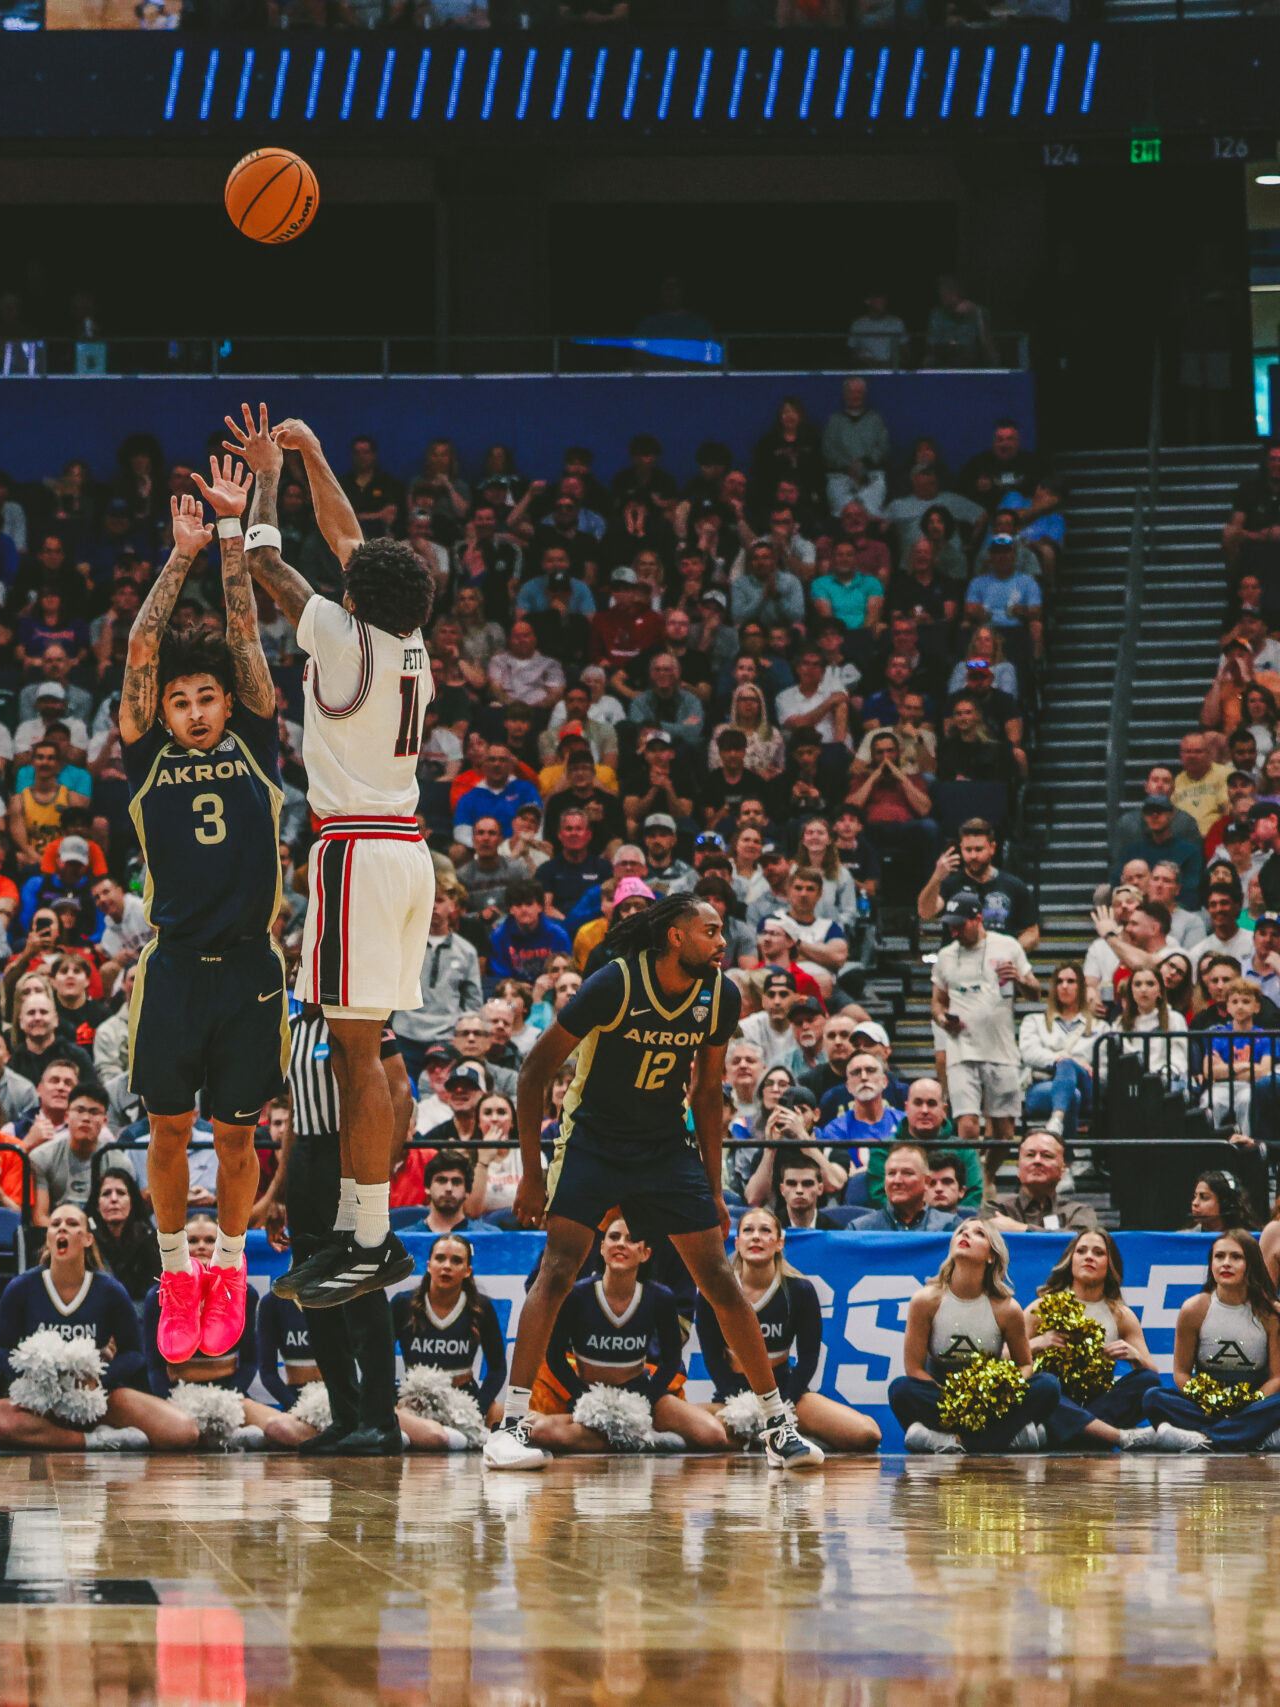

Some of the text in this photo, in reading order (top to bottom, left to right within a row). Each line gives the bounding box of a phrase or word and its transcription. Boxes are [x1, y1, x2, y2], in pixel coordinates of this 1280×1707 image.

[1043, 144, 1079, 166] 124
[1131, 139, 1161, 163] EXIT
[1213, 136, 1248, 159] 126
[403, 648, 424, 670] PETT
[394, 675, 419, 757] 11
[156, 760, 251, 787] AKRON
[192, 793, 227, 845] 3
[623, 1028, 705, 1046] AKRON
[634, 1050, 677, 1090] 12
[410, 1336, 470, 1355] AKRON
[586, 1334, 647, 1352] AKRON
[942, 1334, 983, 1358] A
[1206, 1340, 1257, 1366] A
